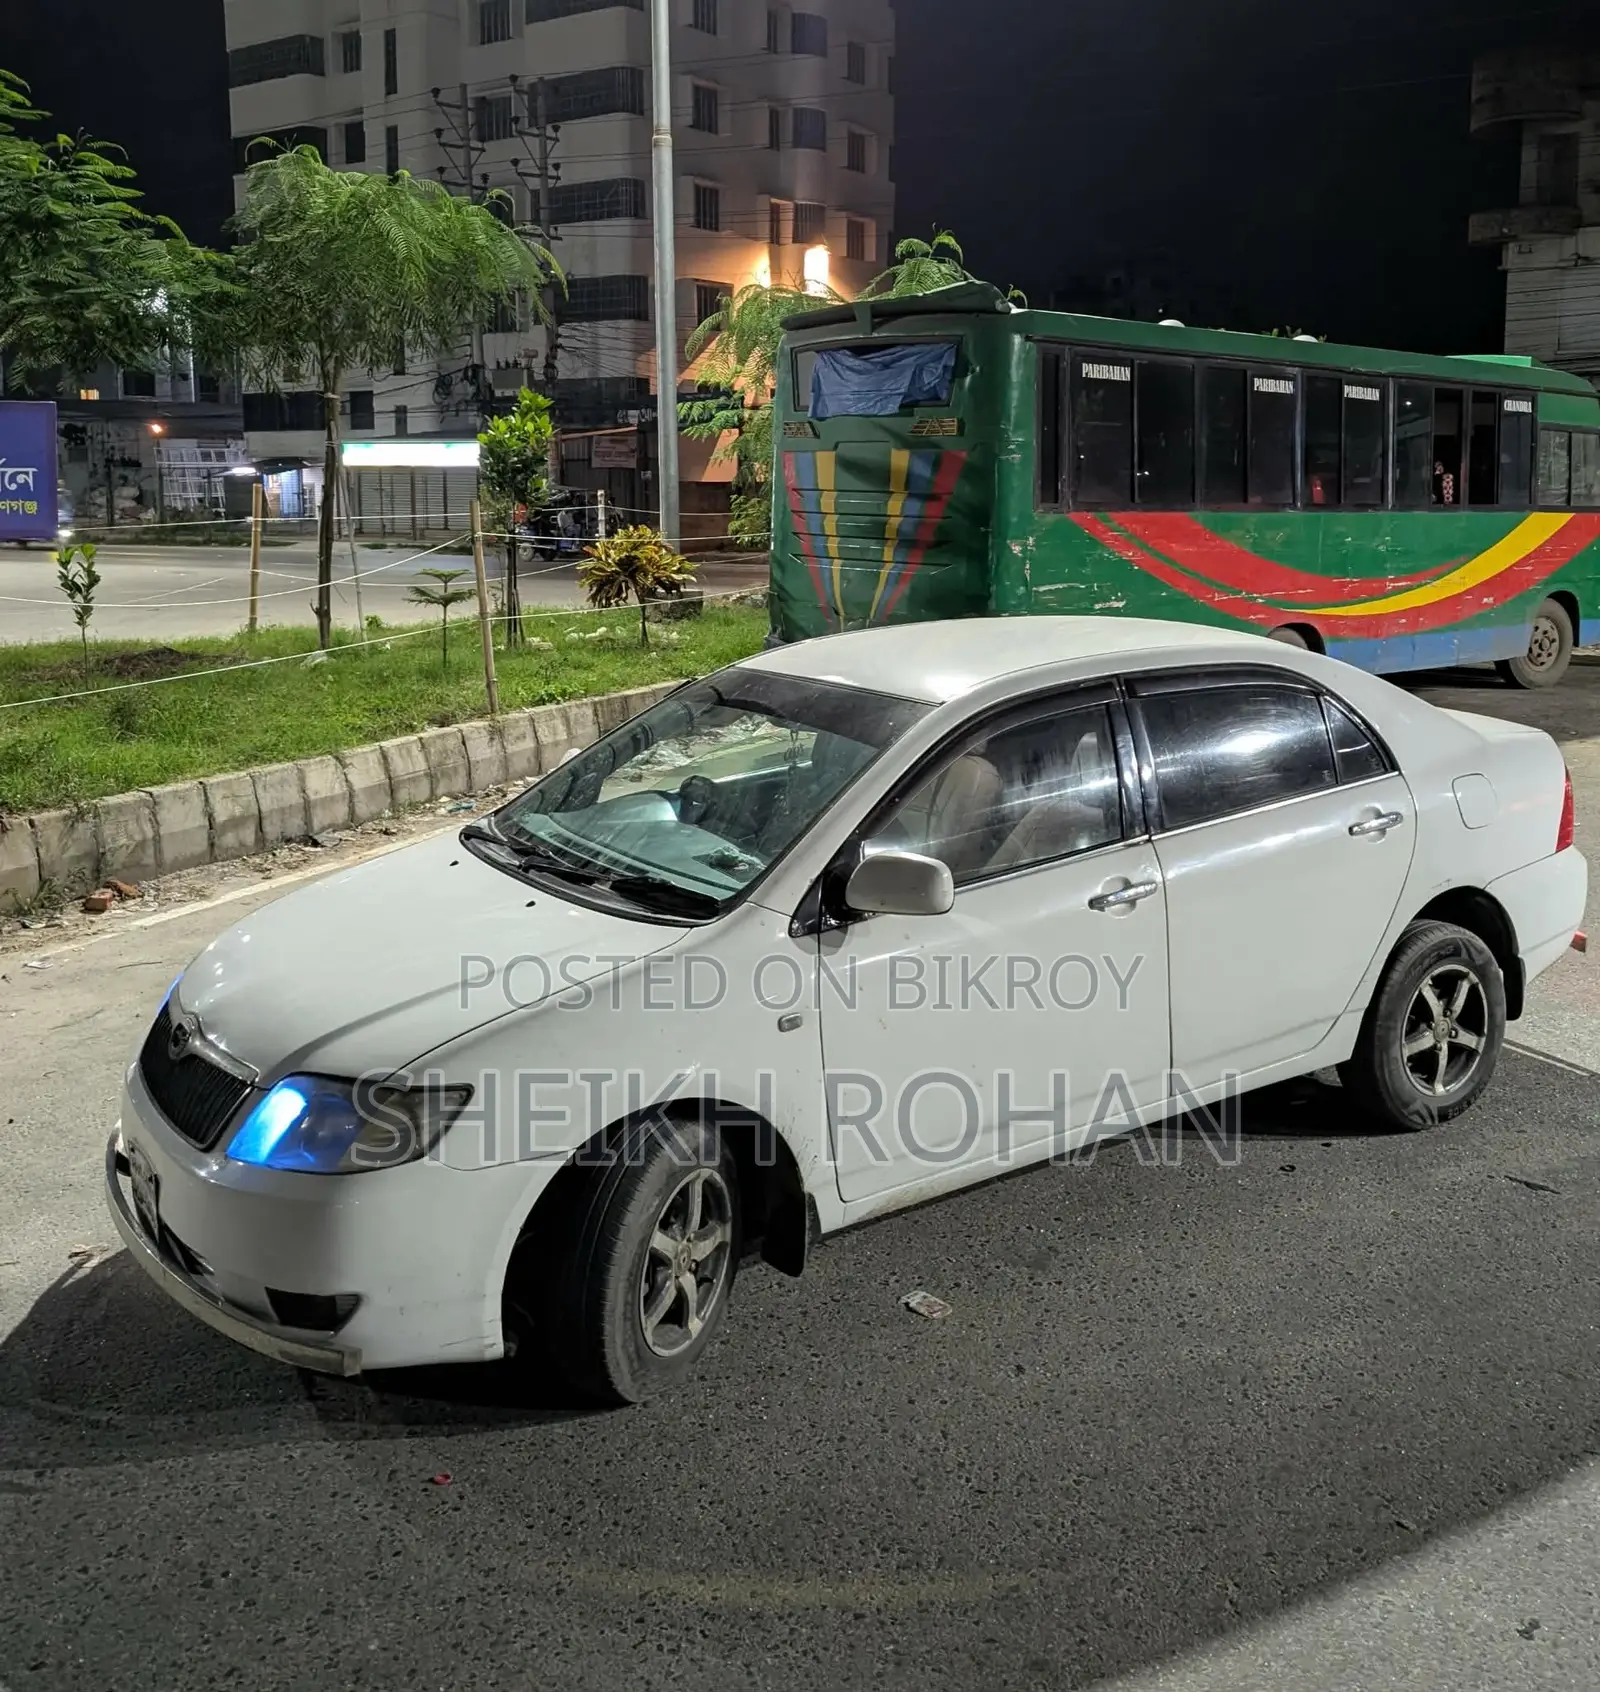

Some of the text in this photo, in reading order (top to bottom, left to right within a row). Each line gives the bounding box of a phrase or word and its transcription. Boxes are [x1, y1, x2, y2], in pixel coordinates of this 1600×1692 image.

[1082, 362, 1131, 382] PARIBAHAN
[1253, 377, 1294, 394] PARIBAHAN
[1504, 399, 1533, 413] CHANDRA
